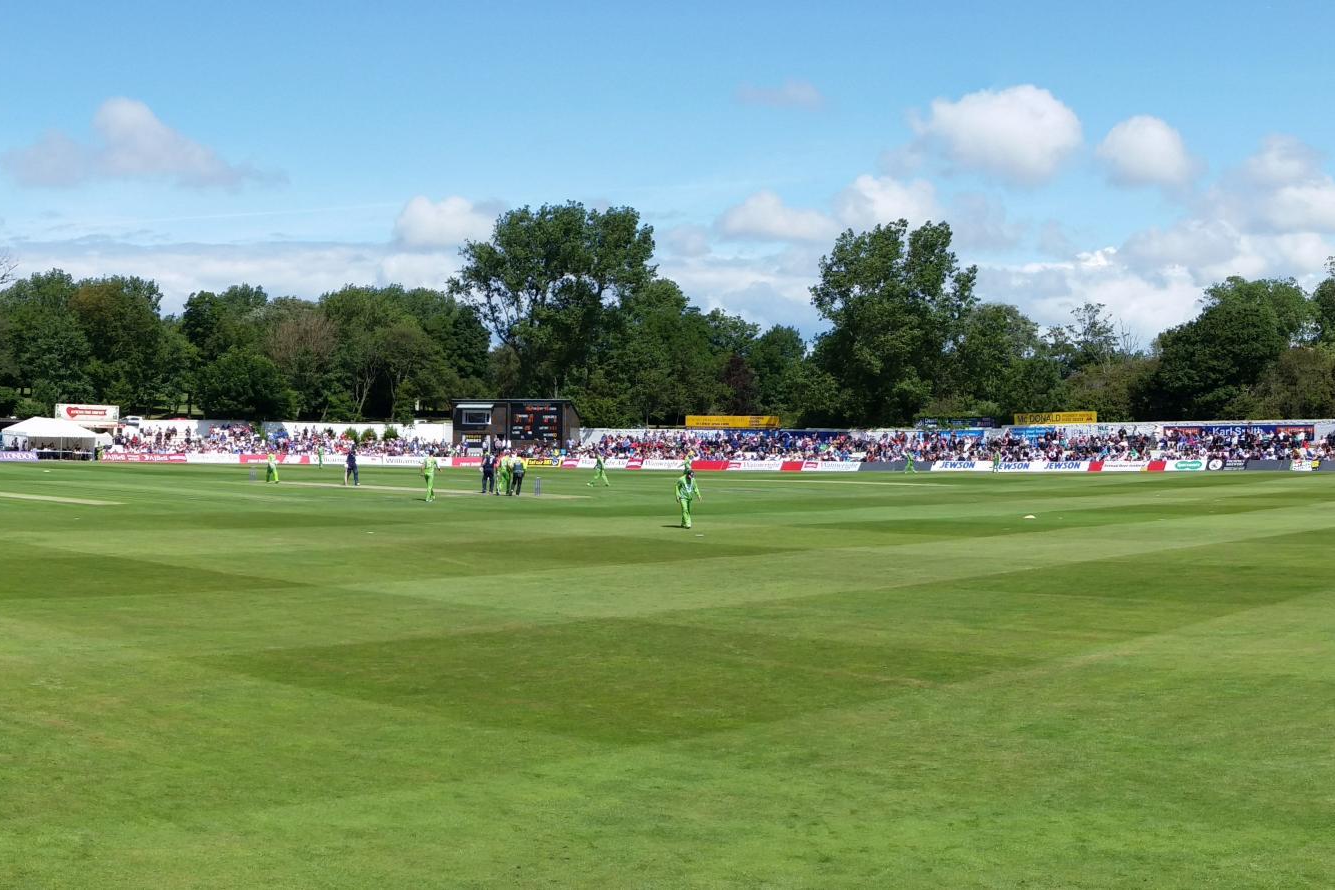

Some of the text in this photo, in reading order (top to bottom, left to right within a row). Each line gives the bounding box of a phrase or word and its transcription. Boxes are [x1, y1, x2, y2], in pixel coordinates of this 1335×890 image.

[1213, 427, 1233, 435] Karl
[0, 451, 36, 460] LONDON
[939, 461, 976, 469] JEWSON
[1044, 462, 1081, 470] JEWSON
